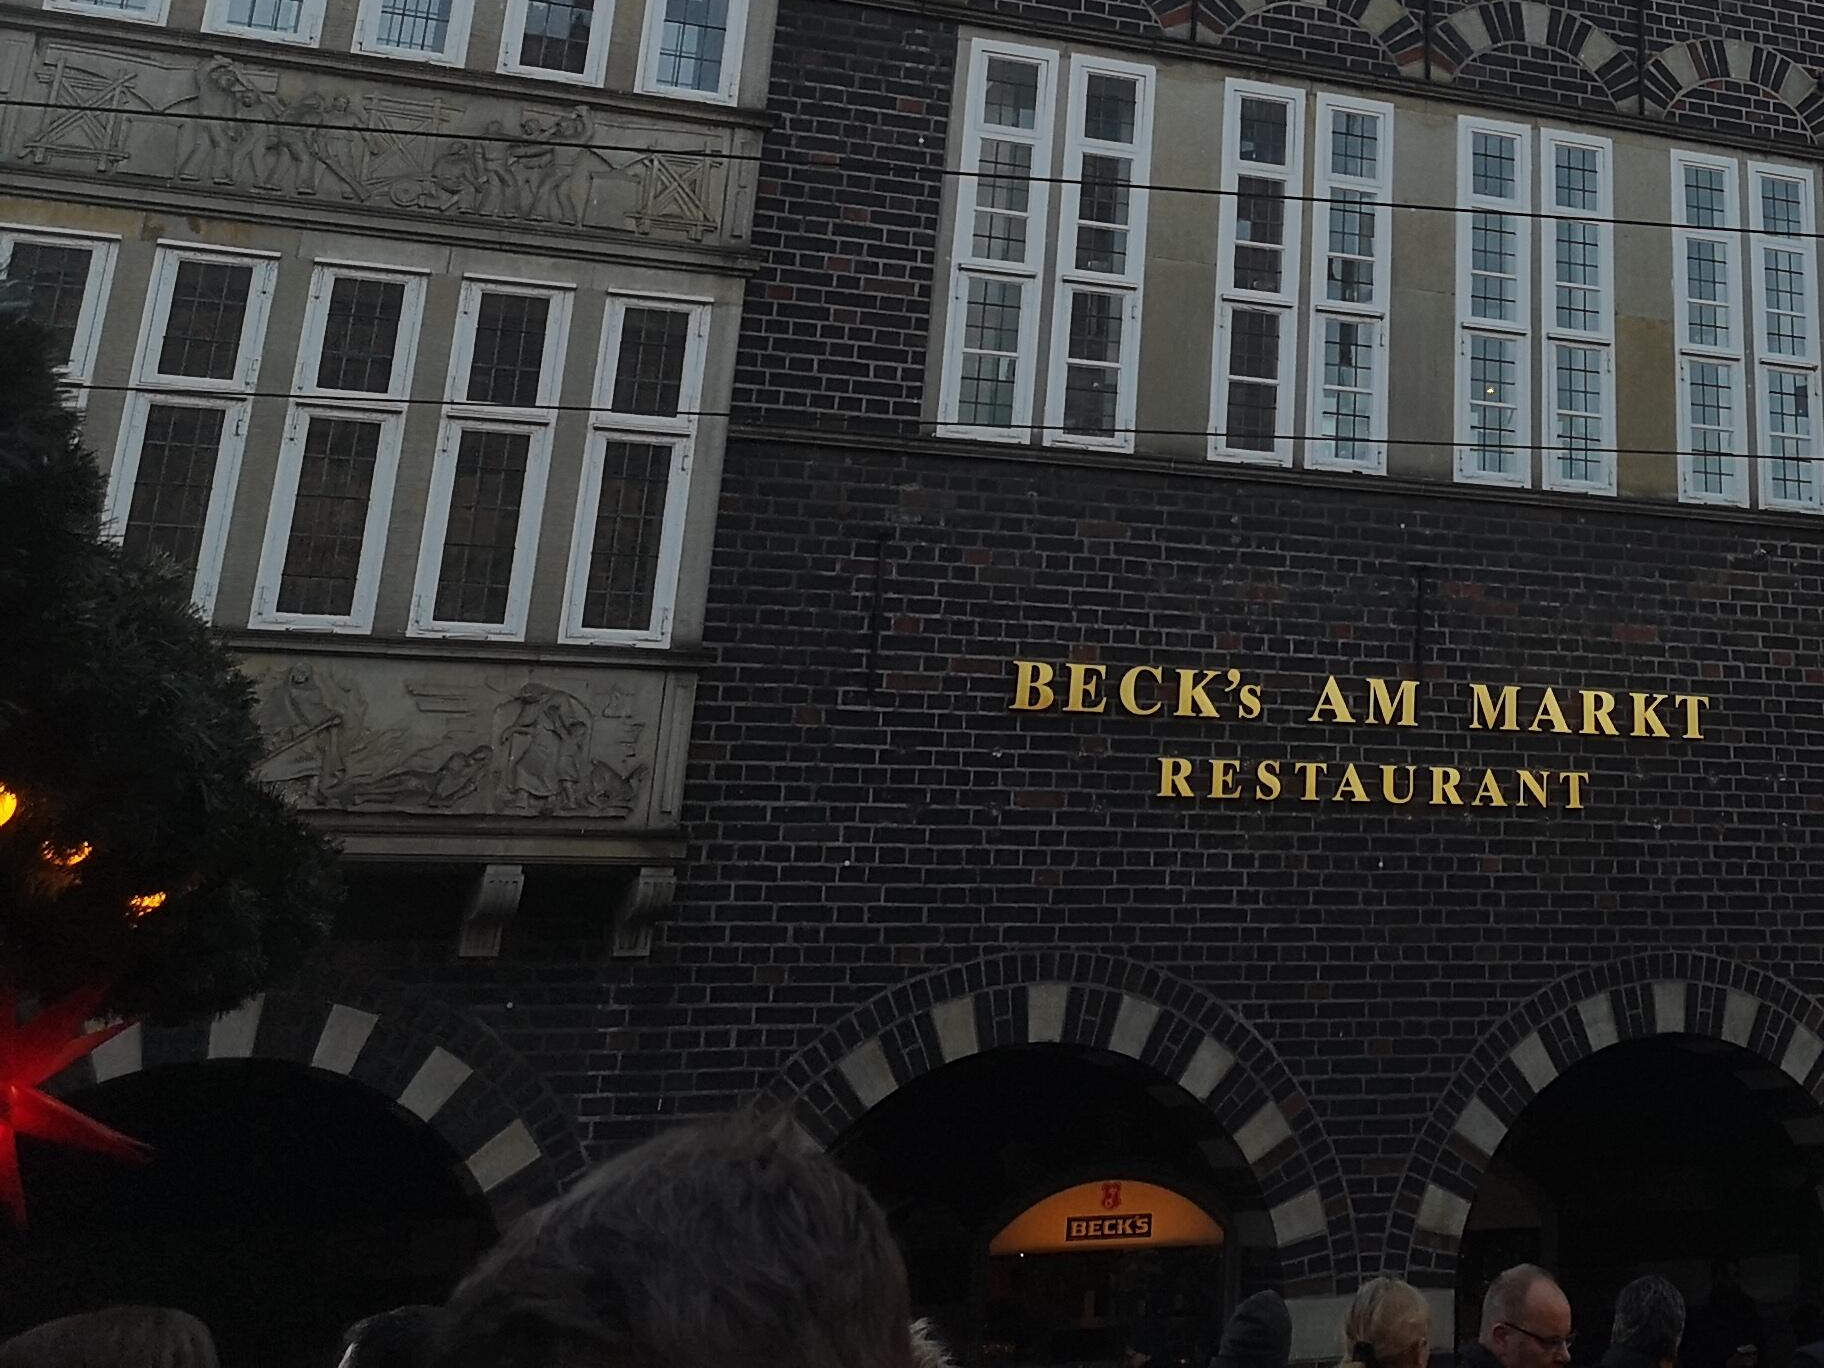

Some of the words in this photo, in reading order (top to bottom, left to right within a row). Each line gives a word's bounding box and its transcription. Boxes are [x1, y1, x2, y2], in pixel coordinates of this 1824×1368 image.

[1008, 660, 1263, 720] BECK's
[1308, 674, 1421, 727] AM
[1469, 682, 1711, 740] MARKT
[1156, 756, 1590, 810] RESTAURANT
[1070, 1217, 1149, 1237] BECK'S
